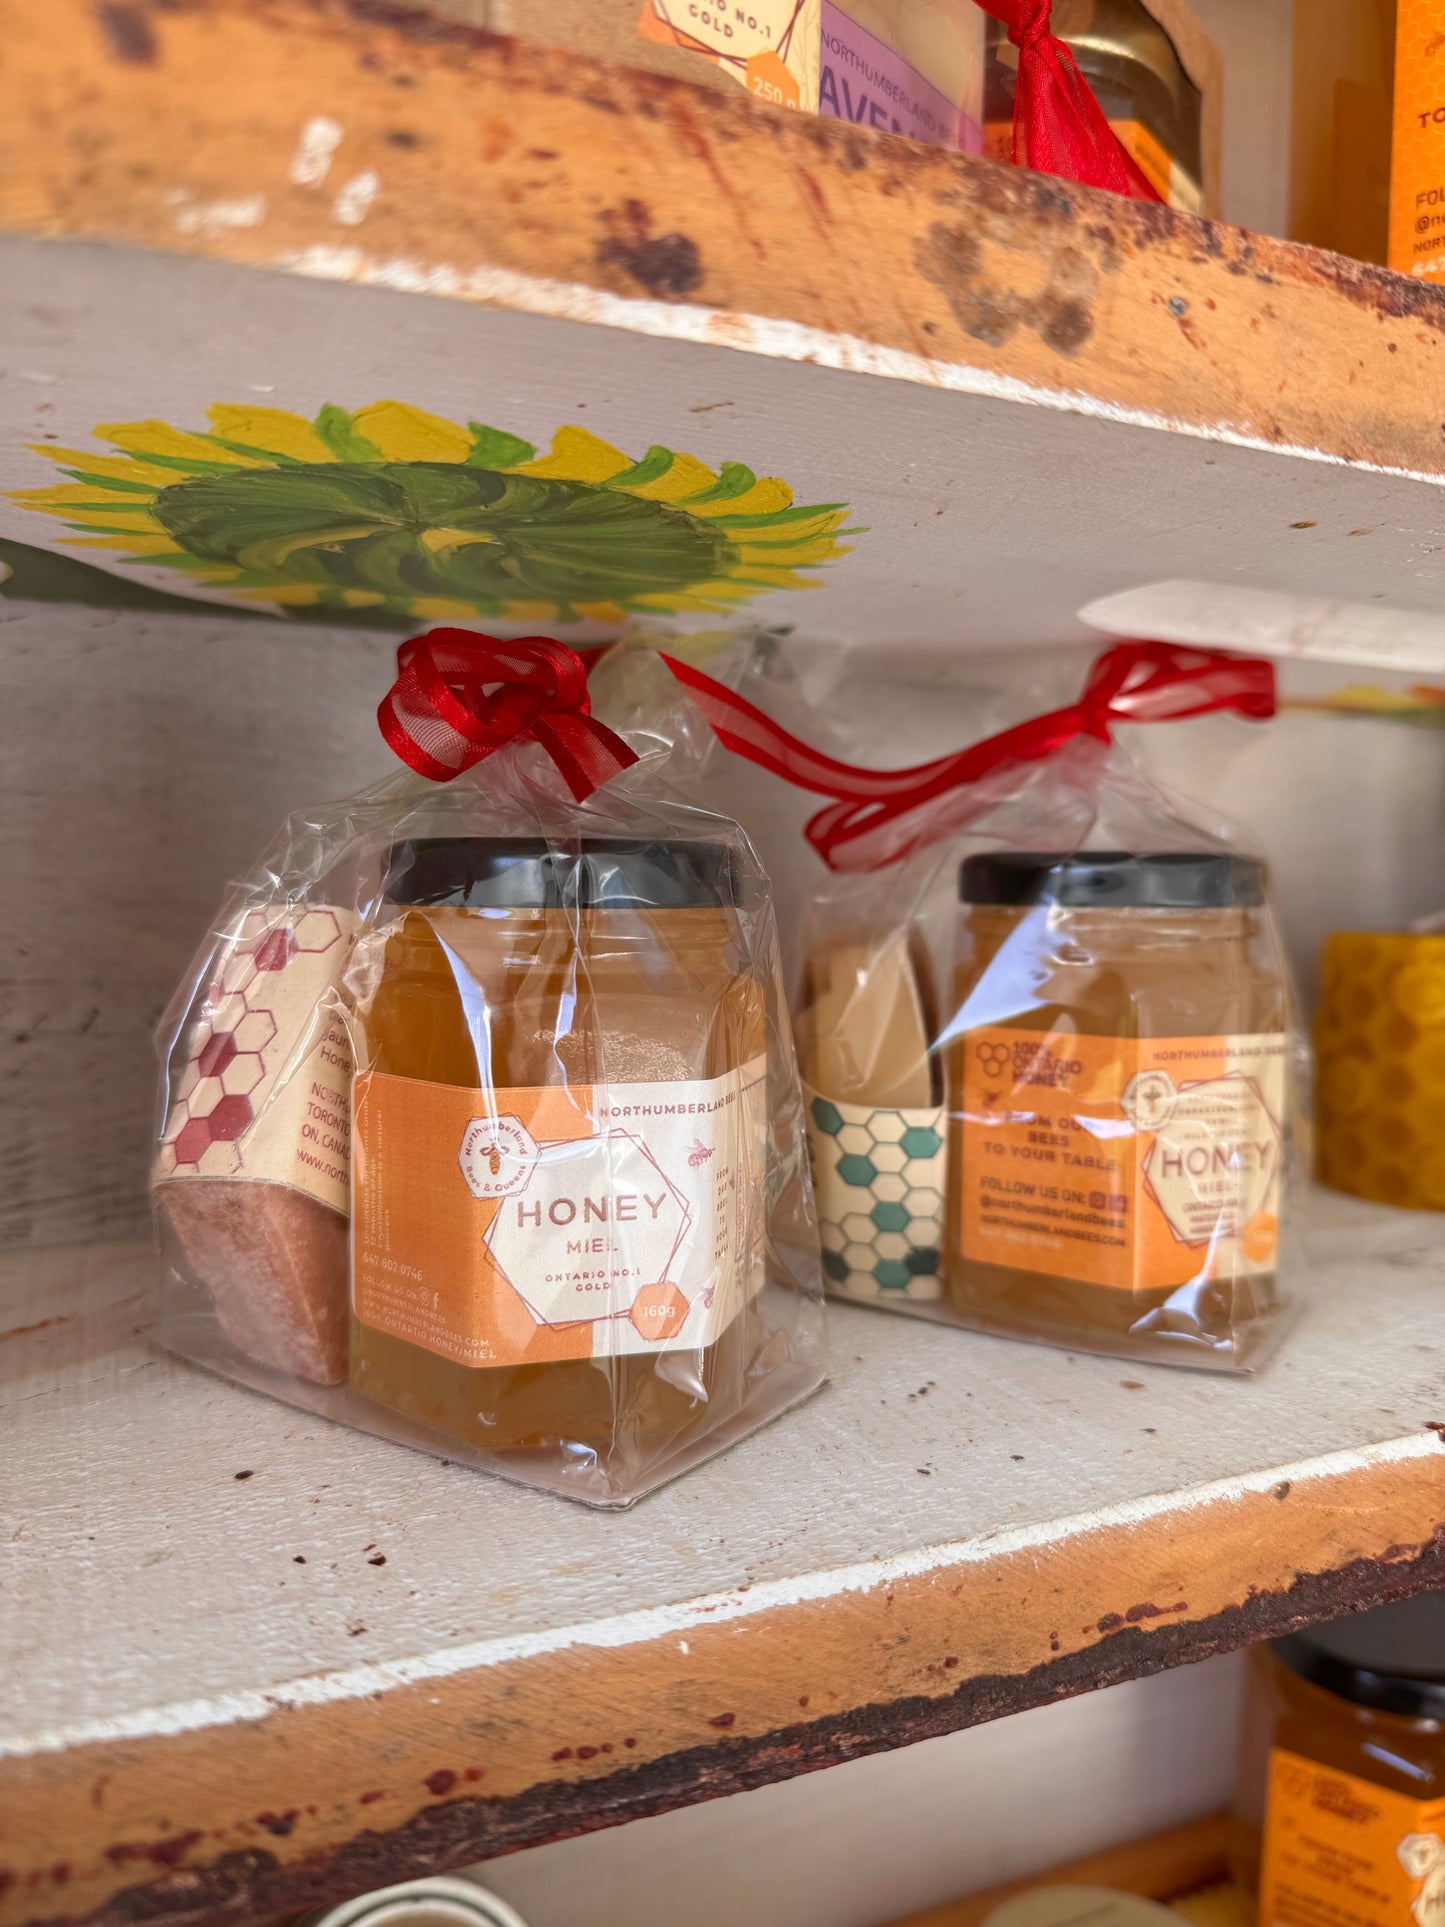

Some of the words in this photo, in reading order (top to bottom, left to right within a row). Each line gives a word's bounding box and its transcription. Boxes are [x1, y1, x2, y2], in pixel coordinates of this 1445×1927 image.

[688, 3, 734, 38] GOLD
[735, 8, 771, 39] NO.1
[753, 75, 783, 105] 250
[820, 29, 936, 132] NORTHUMBERLAND
[819, 65, 916, 138] AVE
[1012, 1053, 1083, 1075] ONARIO
[600, 1099, 724, 1117] NORTHUMBERLAND
[301, 1123, 320, 1145] ON,
[1027, 1131, 1070, 1146] BEES
[983, 1140, 1004, 1155] TO
[1010, 1145, 1056, 1162] YOUR
[1062, 1151, 1117, 1171] TABLE
[980, 1175, 1035, 1196] FOLLOW
[1039, 1184, 1059, 1200] US
[517, 1192, 667, 1228] HONEY
[363, 1251, 380, 1265] 647
[382, 1258, 398, 1272] 802
[400, 1263, 423, 1281] 0746
[545, 1270, 605, 1282] ONTARIO
[643, 1304, 676, 1318] 160g
